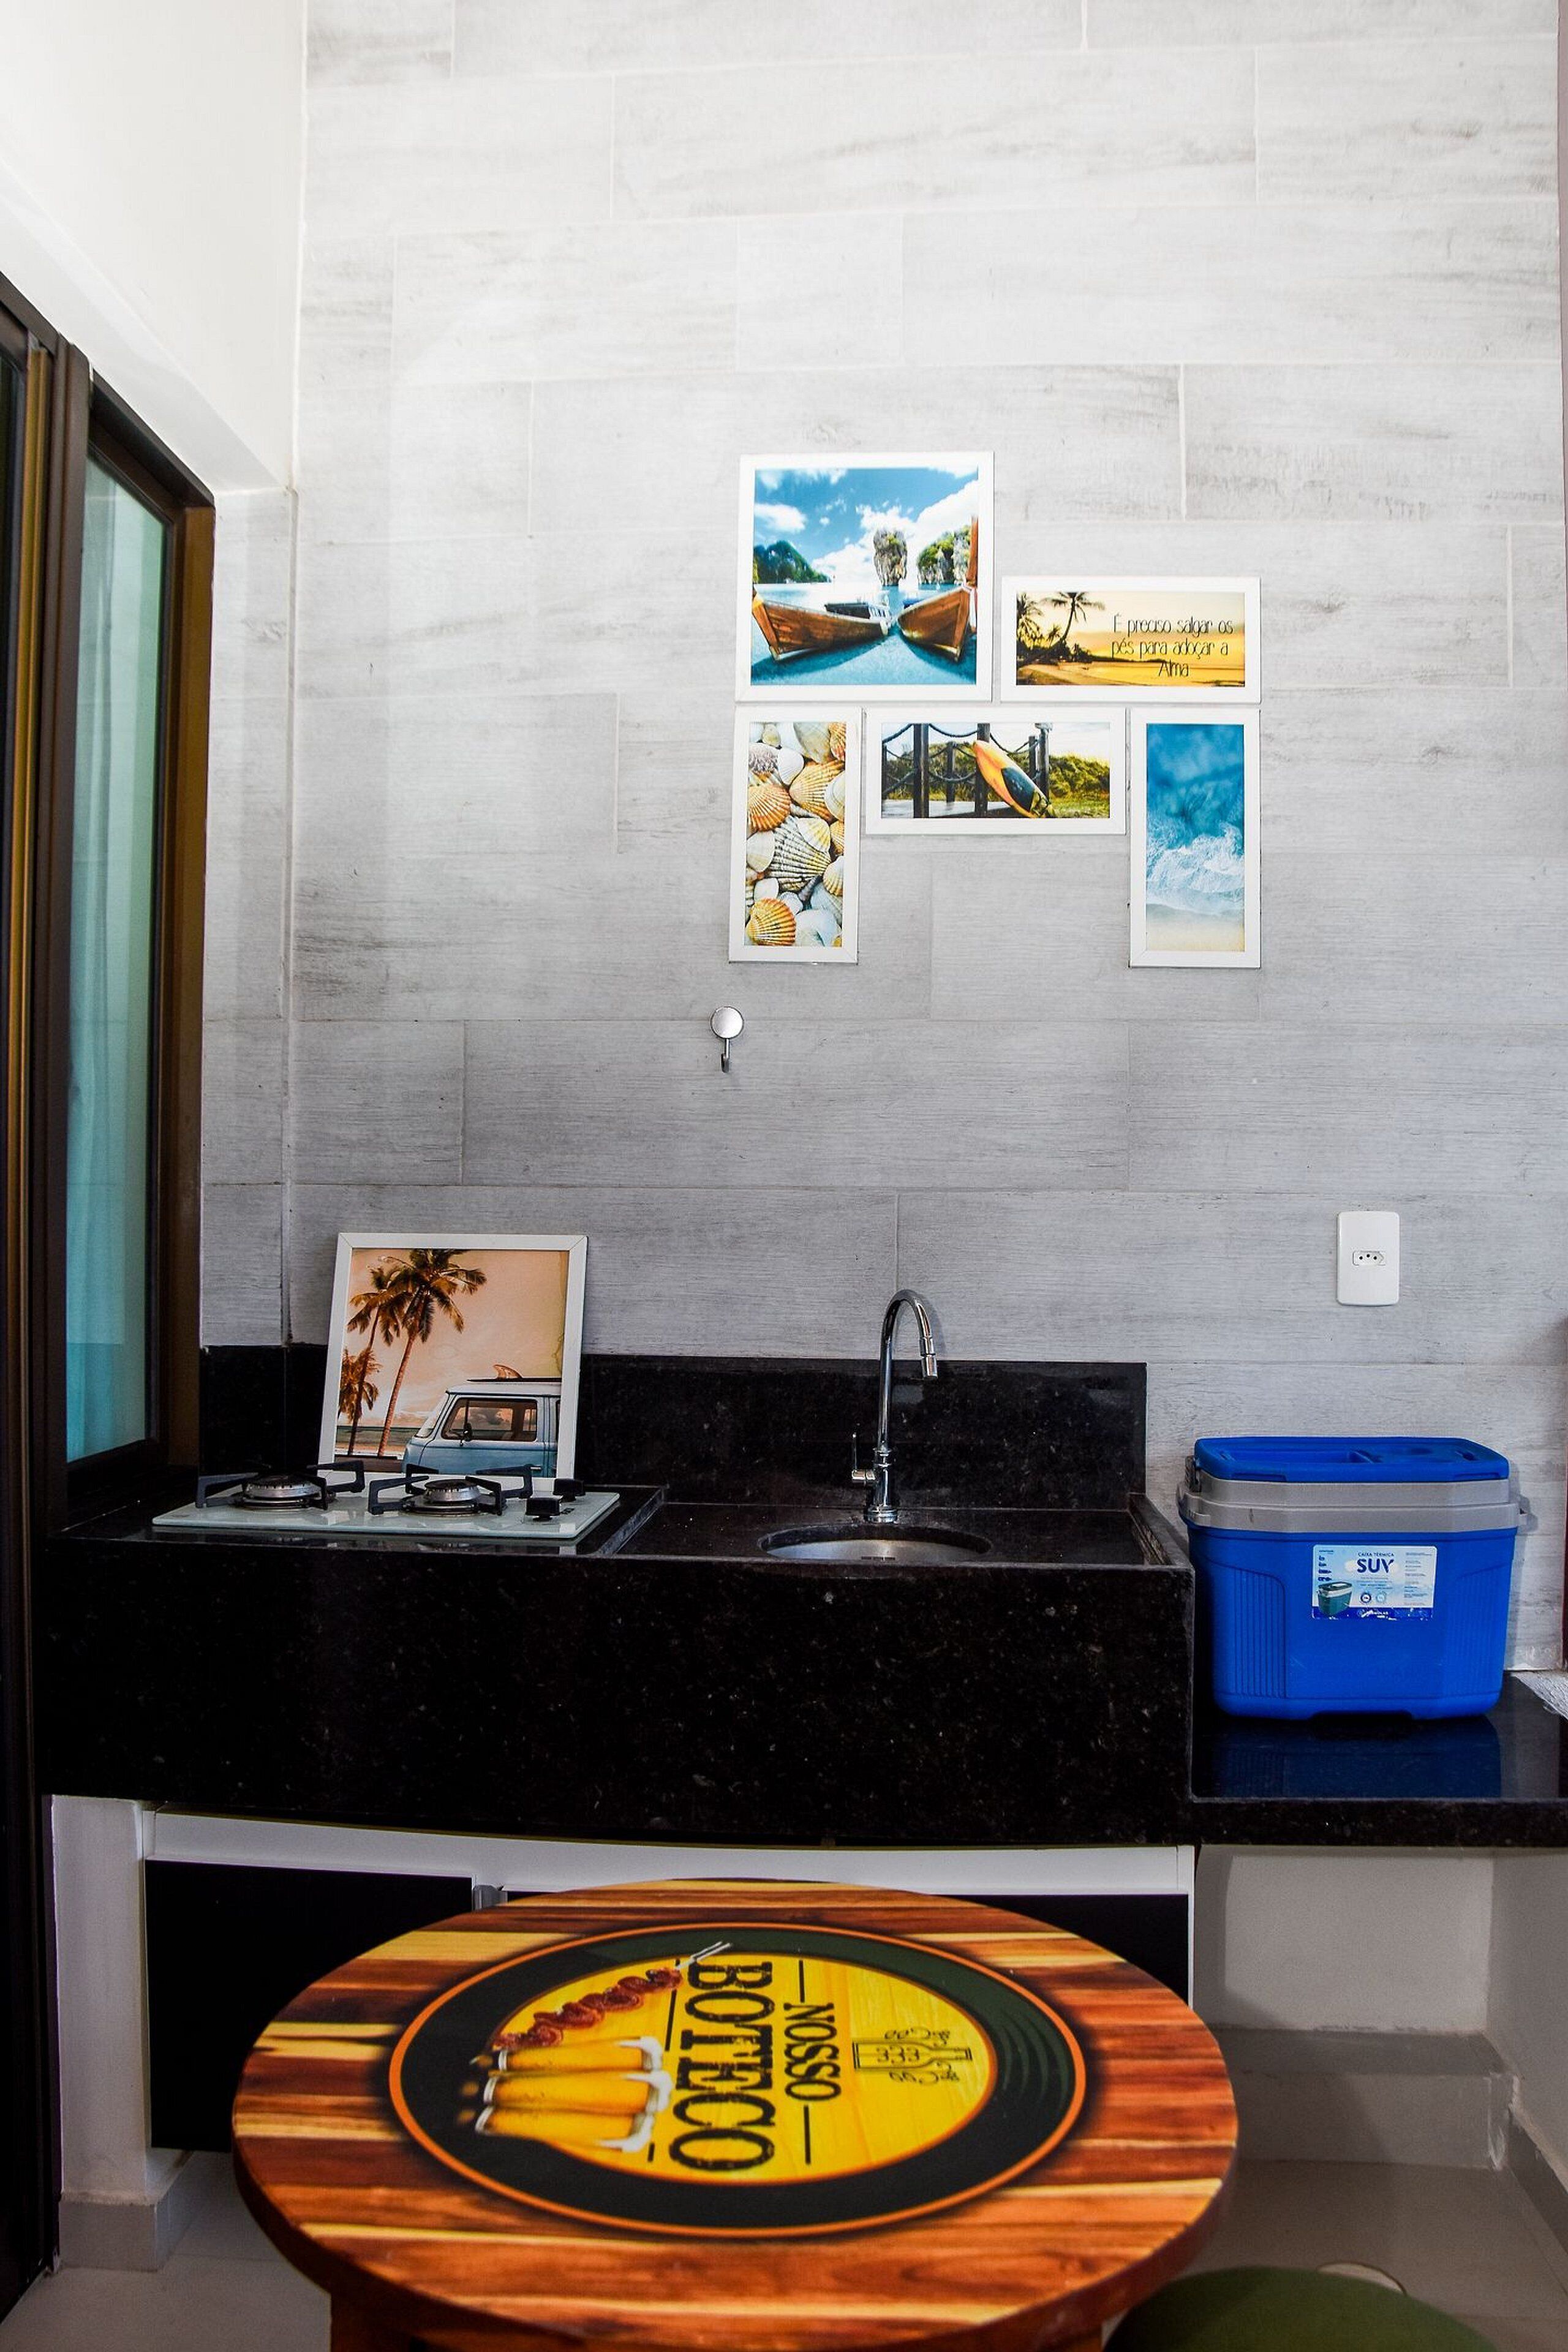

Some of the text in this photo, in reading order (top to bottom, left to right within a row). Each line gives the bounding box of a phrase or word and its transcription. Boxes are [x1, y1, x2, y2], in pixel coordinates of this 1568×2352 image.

[1114, 612, 1234, 638] É preciso salgar os
[1112, 638, 1228, 660] pés para adoçar a
[1158, 658, 1189, 677] Alma
[1357, 1558, 1395, 1574] SUV
[783, 2002, 842, 2101] NOSSO
[669, 1961, 776, 2171] BOTECO
